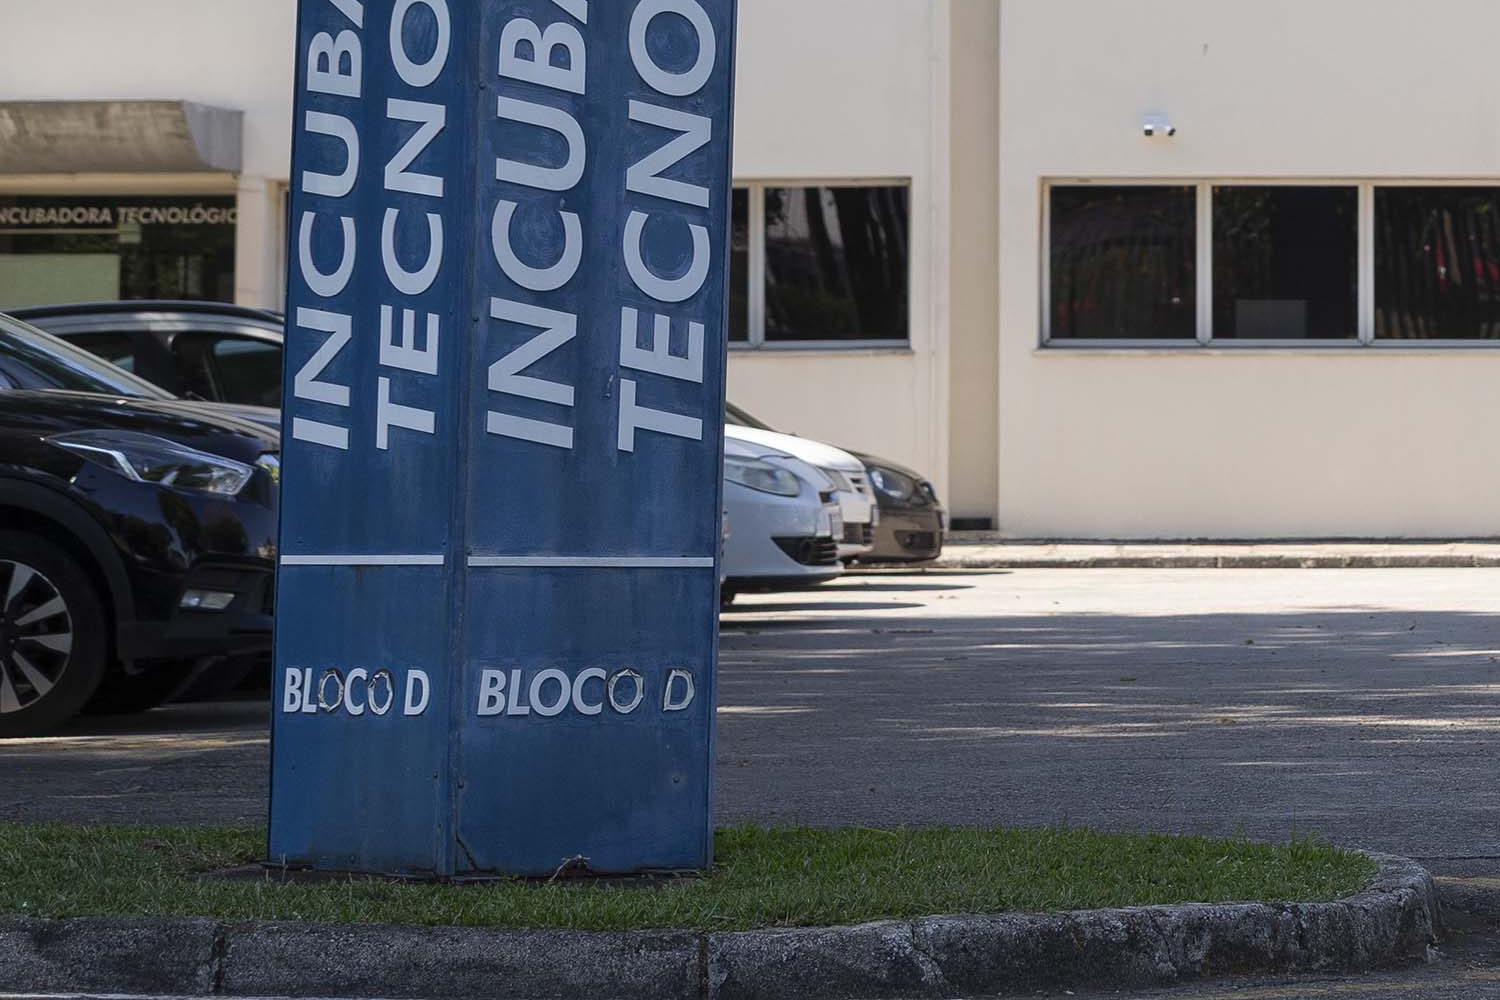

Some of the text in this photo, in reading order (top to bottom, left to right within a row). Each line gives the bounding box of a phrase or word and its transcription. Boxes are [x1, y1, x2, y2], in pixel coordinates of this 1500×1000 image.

[0, 202, 238, 225] NCUBADORA TECNOLÓGIC
[283, 667, 430, 716] BLOCO D
[477, 667, 696, 717] BLOCO D
